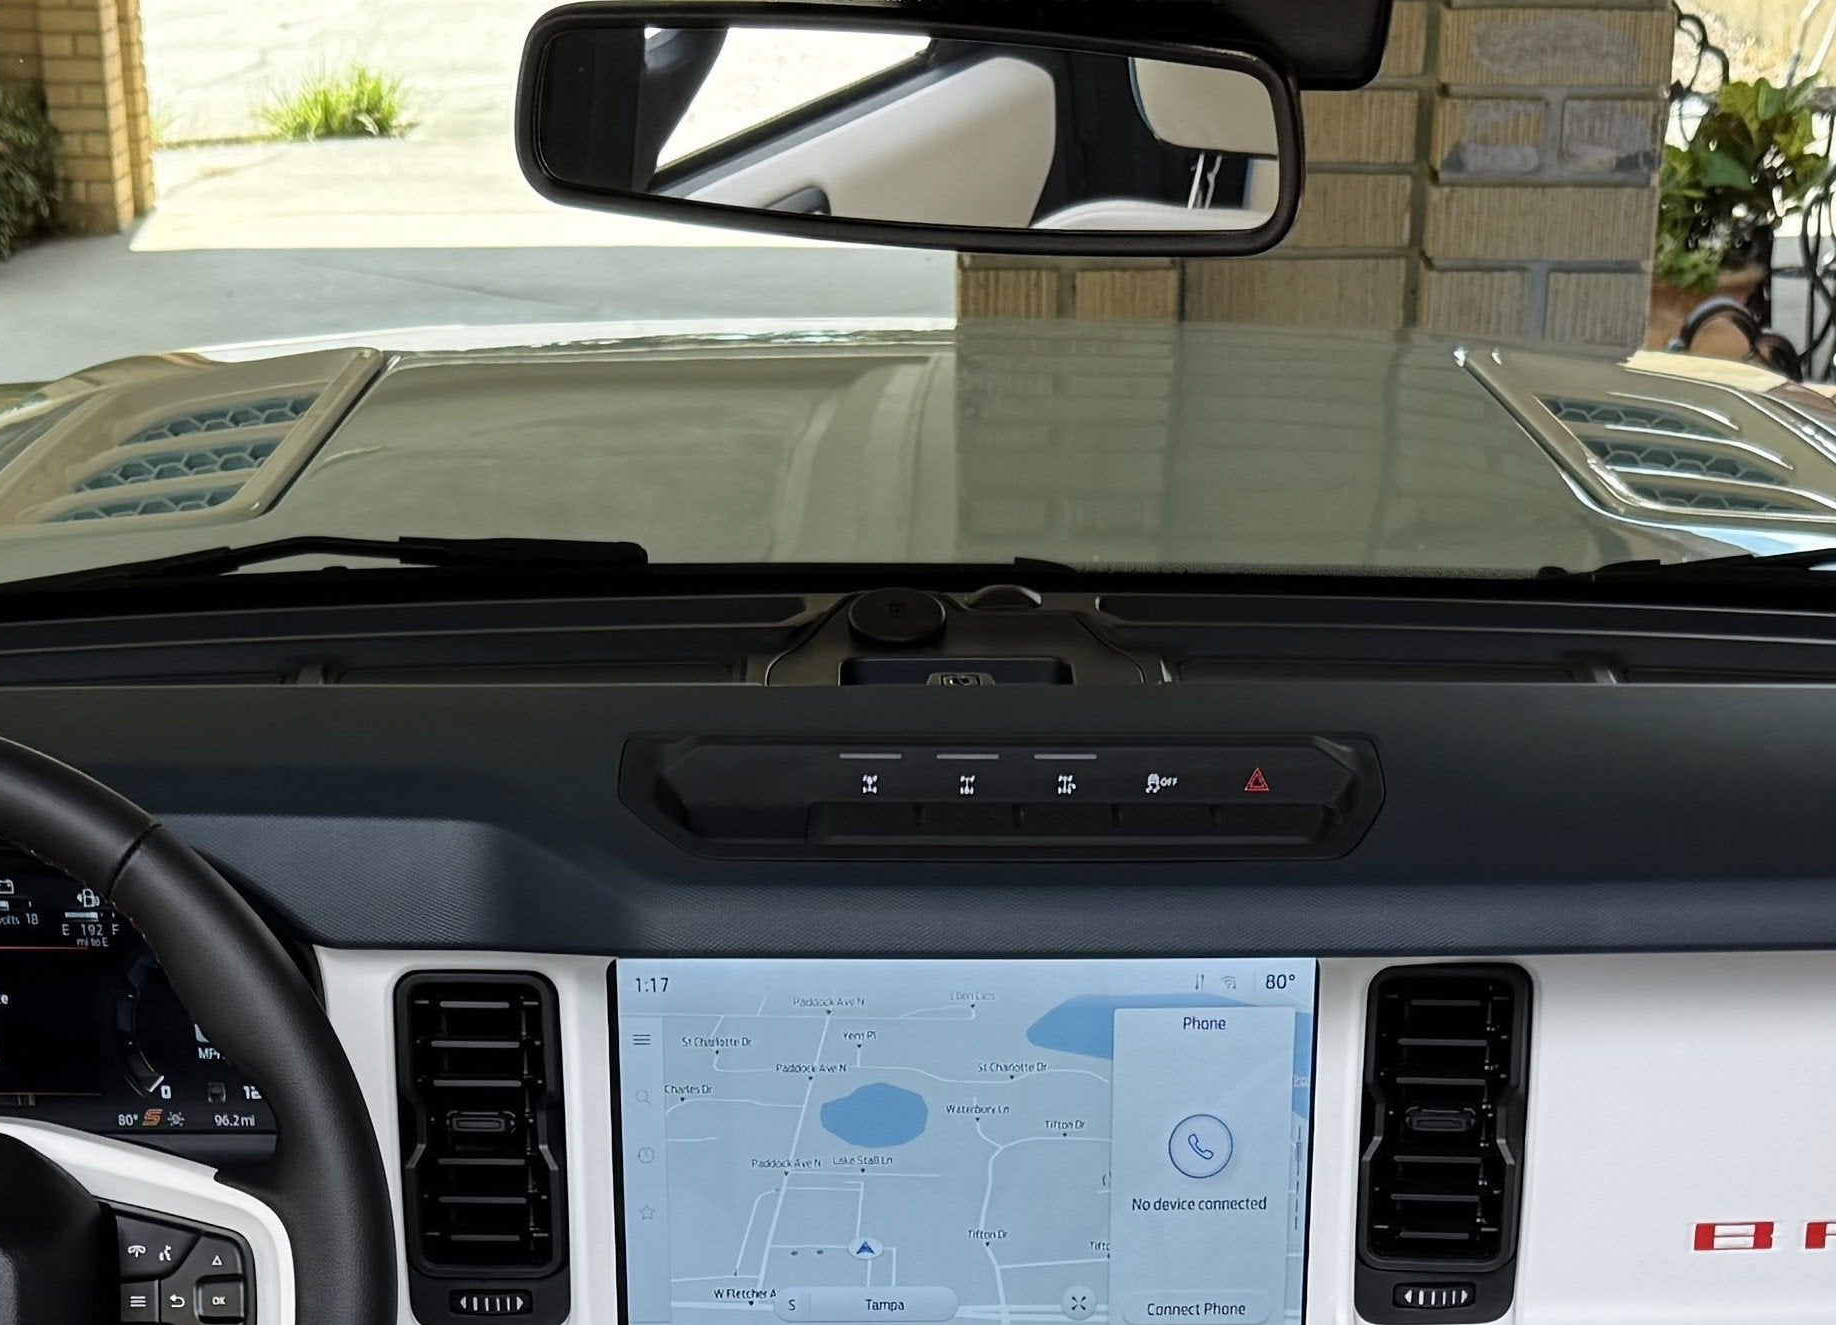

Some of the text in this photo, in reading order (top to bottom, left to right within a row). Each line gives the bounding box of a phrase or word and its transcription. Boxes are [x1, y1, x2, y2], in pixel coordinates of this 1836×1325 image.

[25, 913, 39, 925] 18
[62, 924, 119, 936] E 192 F
[635, 977, 669, 993] 1:17
[1265, 973, 1296, 990] 80°
[1183, 1016, 1226, 1031] Phone
[776, 1064, 815, 1074] Paddock
[819, 1064, 838, 1073] Ave
[977, 1062, 1047, 1072] St Charlotte Dr
[161, 1085, 171, 1099] 0
[702, 1085, 713, 1094] Dr
[1075, 1120, 1085, 1129] Dr
[1132, 1197, 1267, 1211] No device connected
[998, 1230, 1008, 1239] Dr
[714, 1289, 725, 1299] W
[727, 1289, 768, 1299] Fletcher
[212, 1296, 226, 1305] OK
[789, 1300, 796, 1311] S
[866, 1299, 905, 1312] Tampa
[1147, 1302, 1246, 1317] Connect Phone
